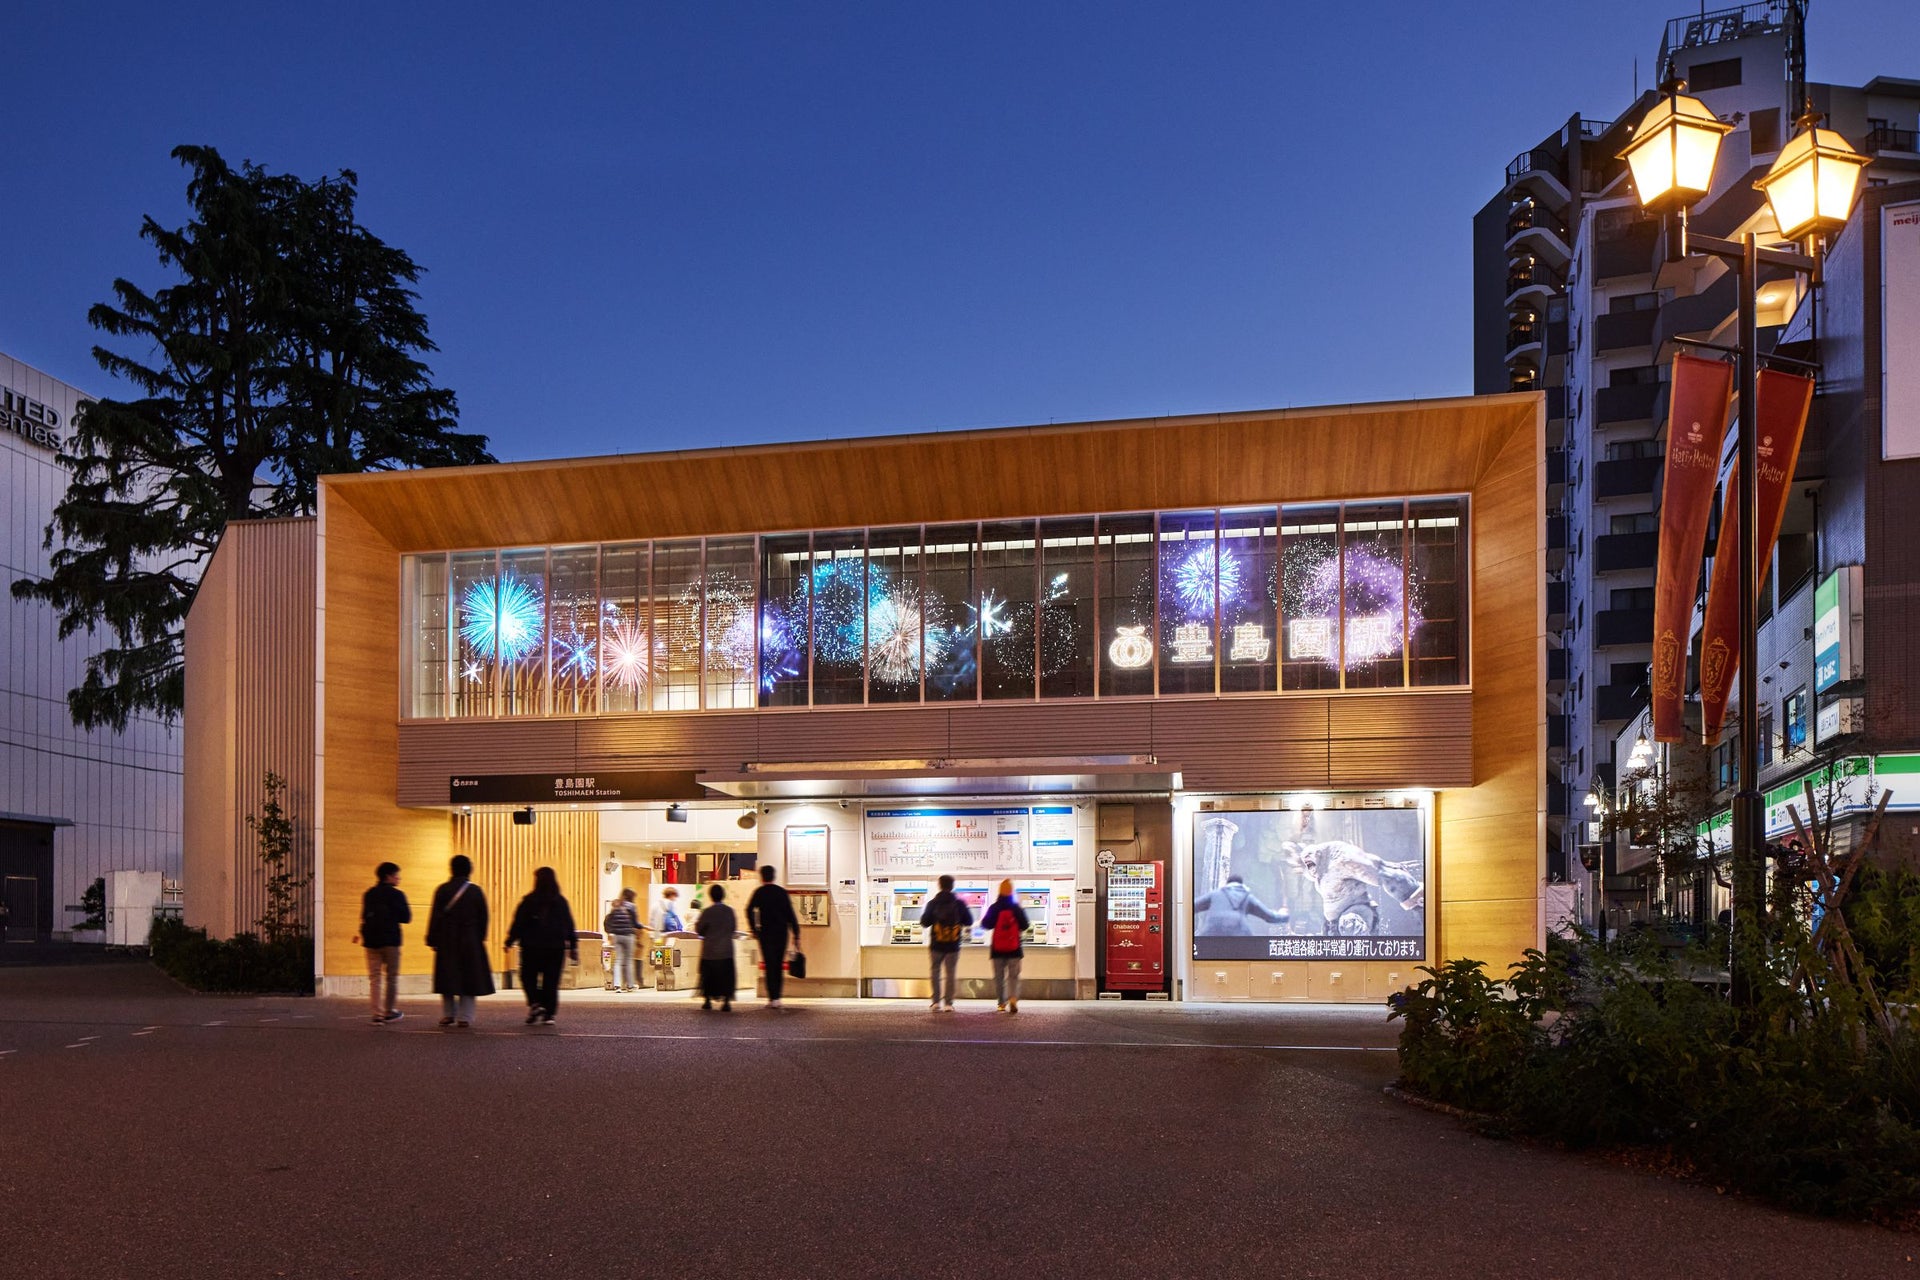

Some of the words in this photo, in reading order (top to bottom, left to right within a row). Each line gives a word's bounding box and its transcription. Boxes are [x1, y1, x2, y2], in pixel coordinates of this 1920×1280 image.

[1893, 214, 1920, 226] meij
[555, 777, 595, 789] 豊島園駅
